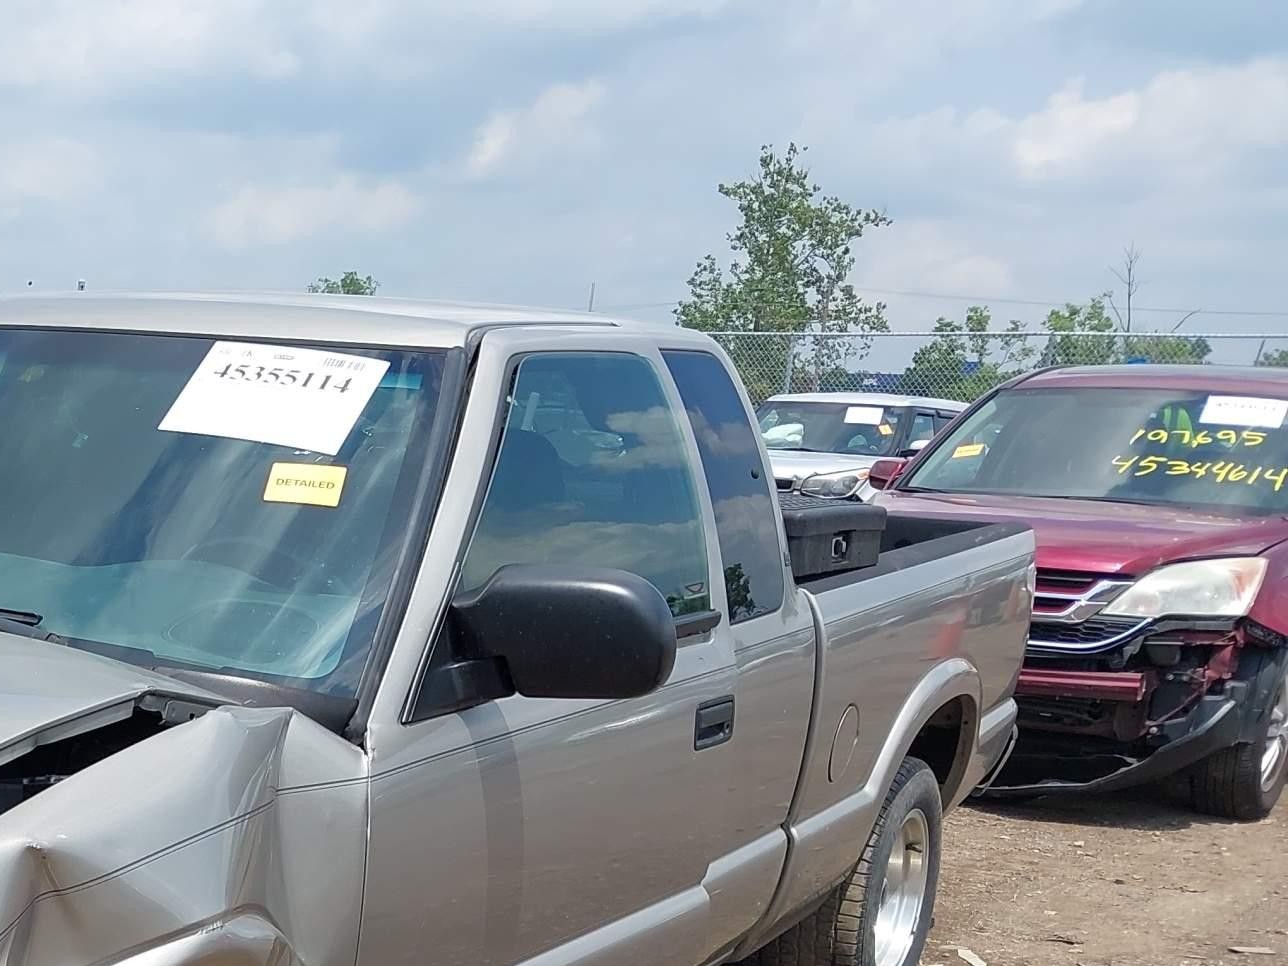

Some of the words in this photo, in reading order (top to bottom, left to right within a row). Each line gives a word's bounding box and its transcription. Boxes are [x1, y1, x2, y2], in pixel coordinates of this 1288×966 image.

[214, 363, 353, 393] 45355114
[1129, 429, 1267, 448] 197,695
[275, 478, 335, 489] DETAILED
[1112, 455, 1288, 491] 45344614
